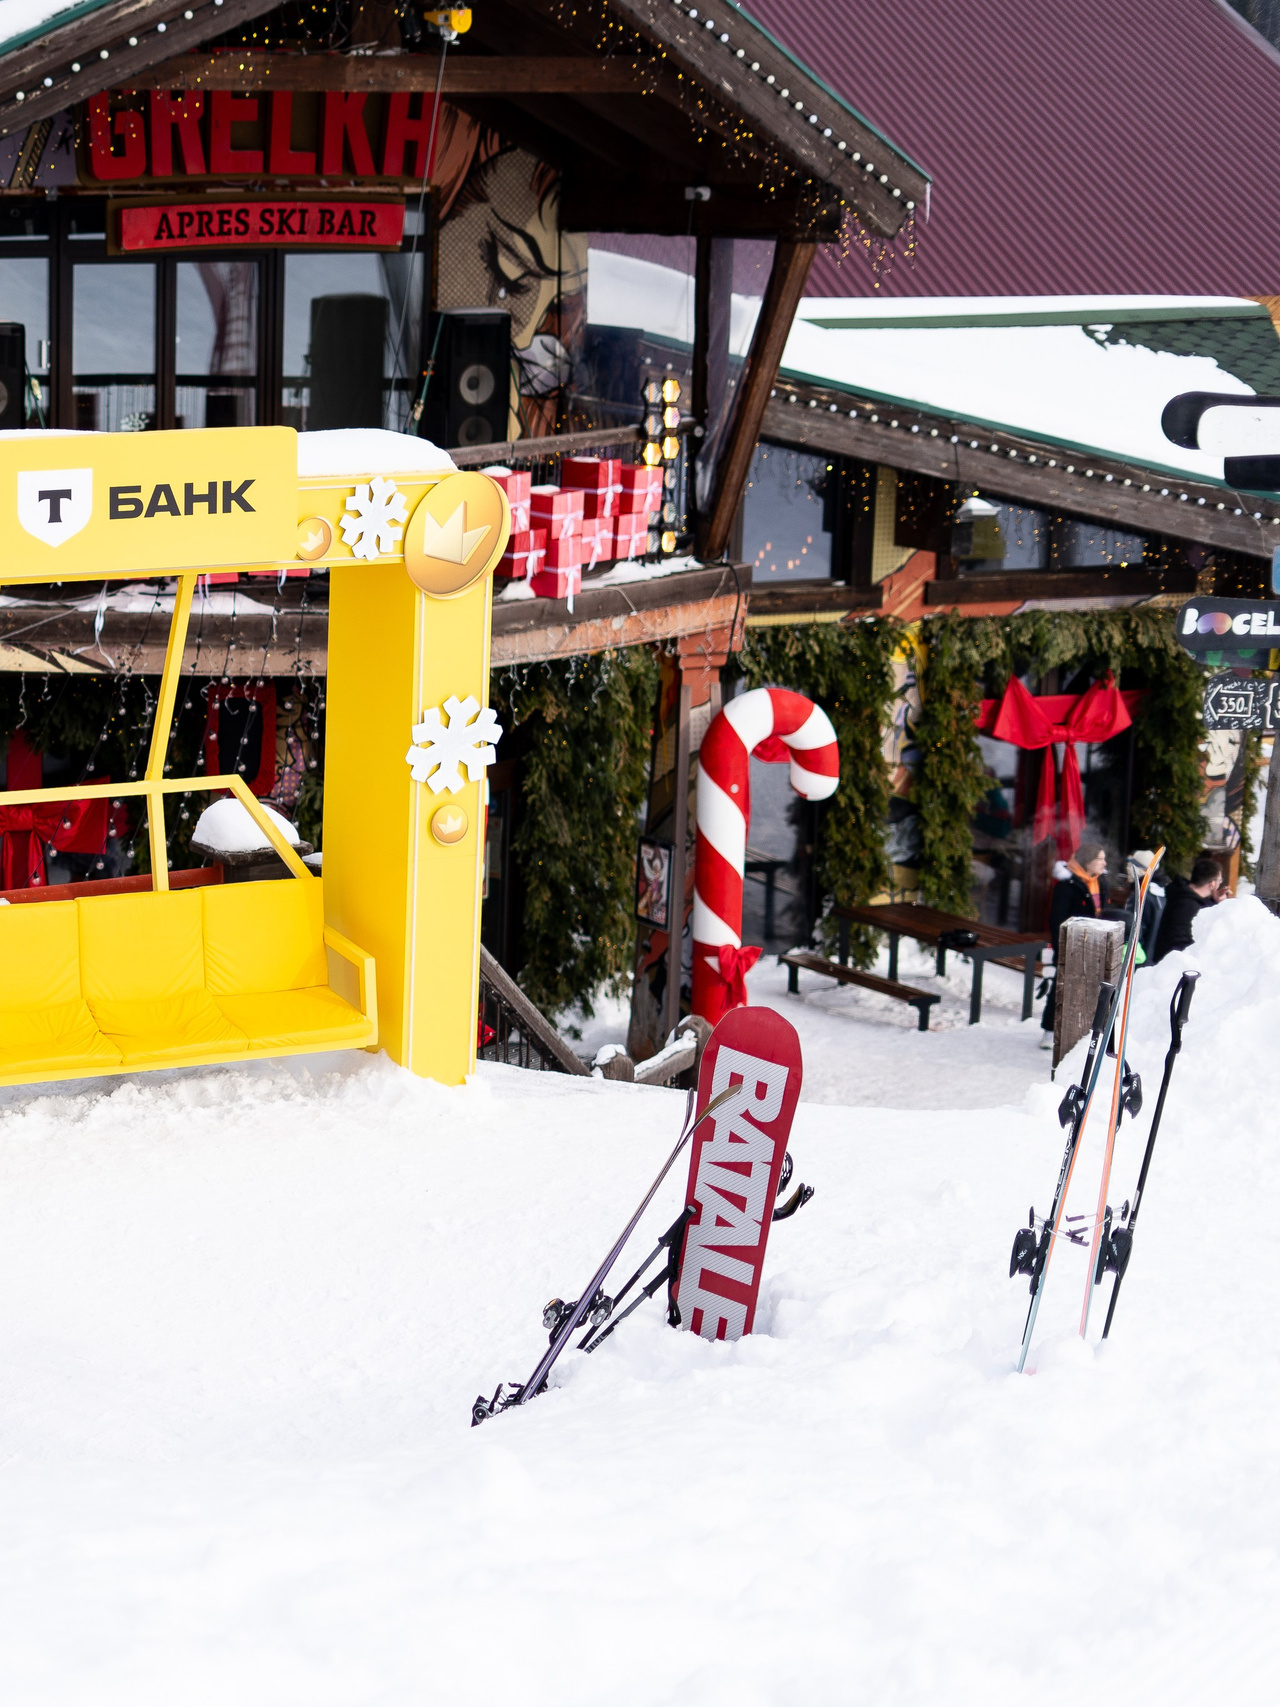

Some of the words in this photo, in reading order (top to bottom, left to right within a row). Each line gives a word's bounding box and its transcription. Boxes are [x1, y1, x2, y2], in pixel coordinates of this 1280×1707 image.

[154, 210, 250, 241] APRES
[259, 209, 308, 236] SKI
[317, 209, 377, 237] BAR
[109, 479, 257, 520] БАНК
